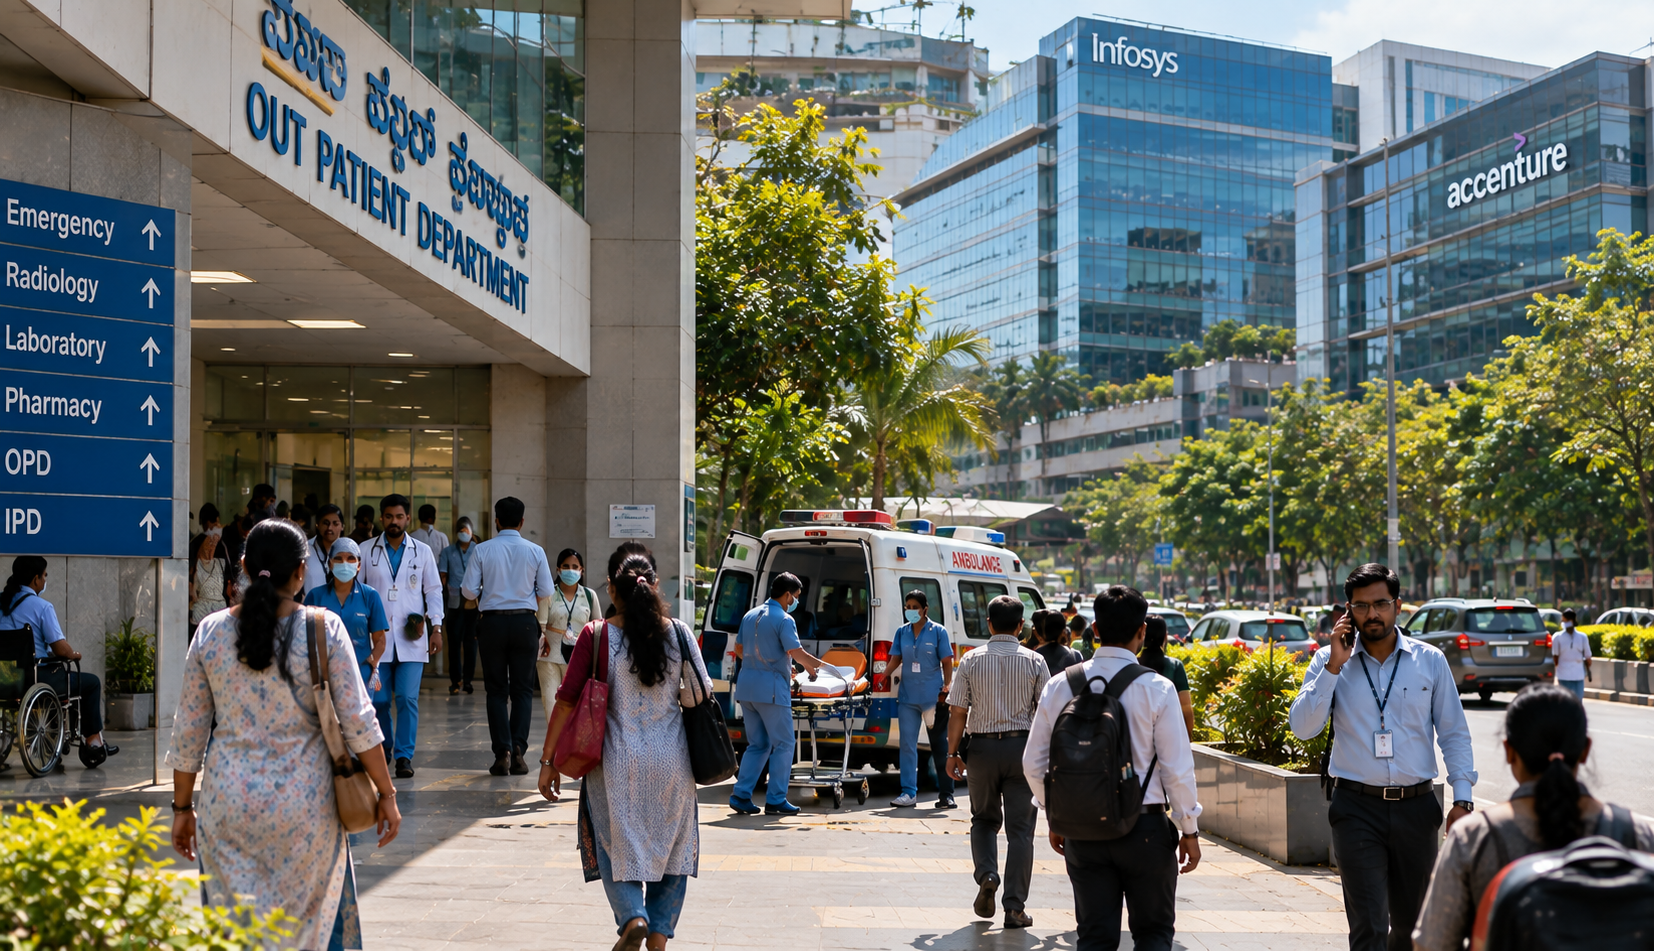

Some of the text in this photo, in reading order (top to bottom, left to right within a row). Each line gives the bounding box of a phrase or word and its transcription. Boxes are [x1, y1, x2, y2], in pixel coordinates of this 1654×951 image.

[1092, 32, 1179, 78] Infosys
[1447, 142, 1568, 209] accenture
[246, 82, 307, 166] OUT
[317, 129, 410, 236] PATIENT
[418, 201, 529, 314] DEPARTMENT
[7, 198, 115, 246] Emergency
[6, 261, 99, 303] Radiology
[6, 325, 106, 364] Laboratory
[6, 387, 101, 424] Pharmacy
[5, 448, 51, 476] OPD
[5, 508, 42, 535] IPD
